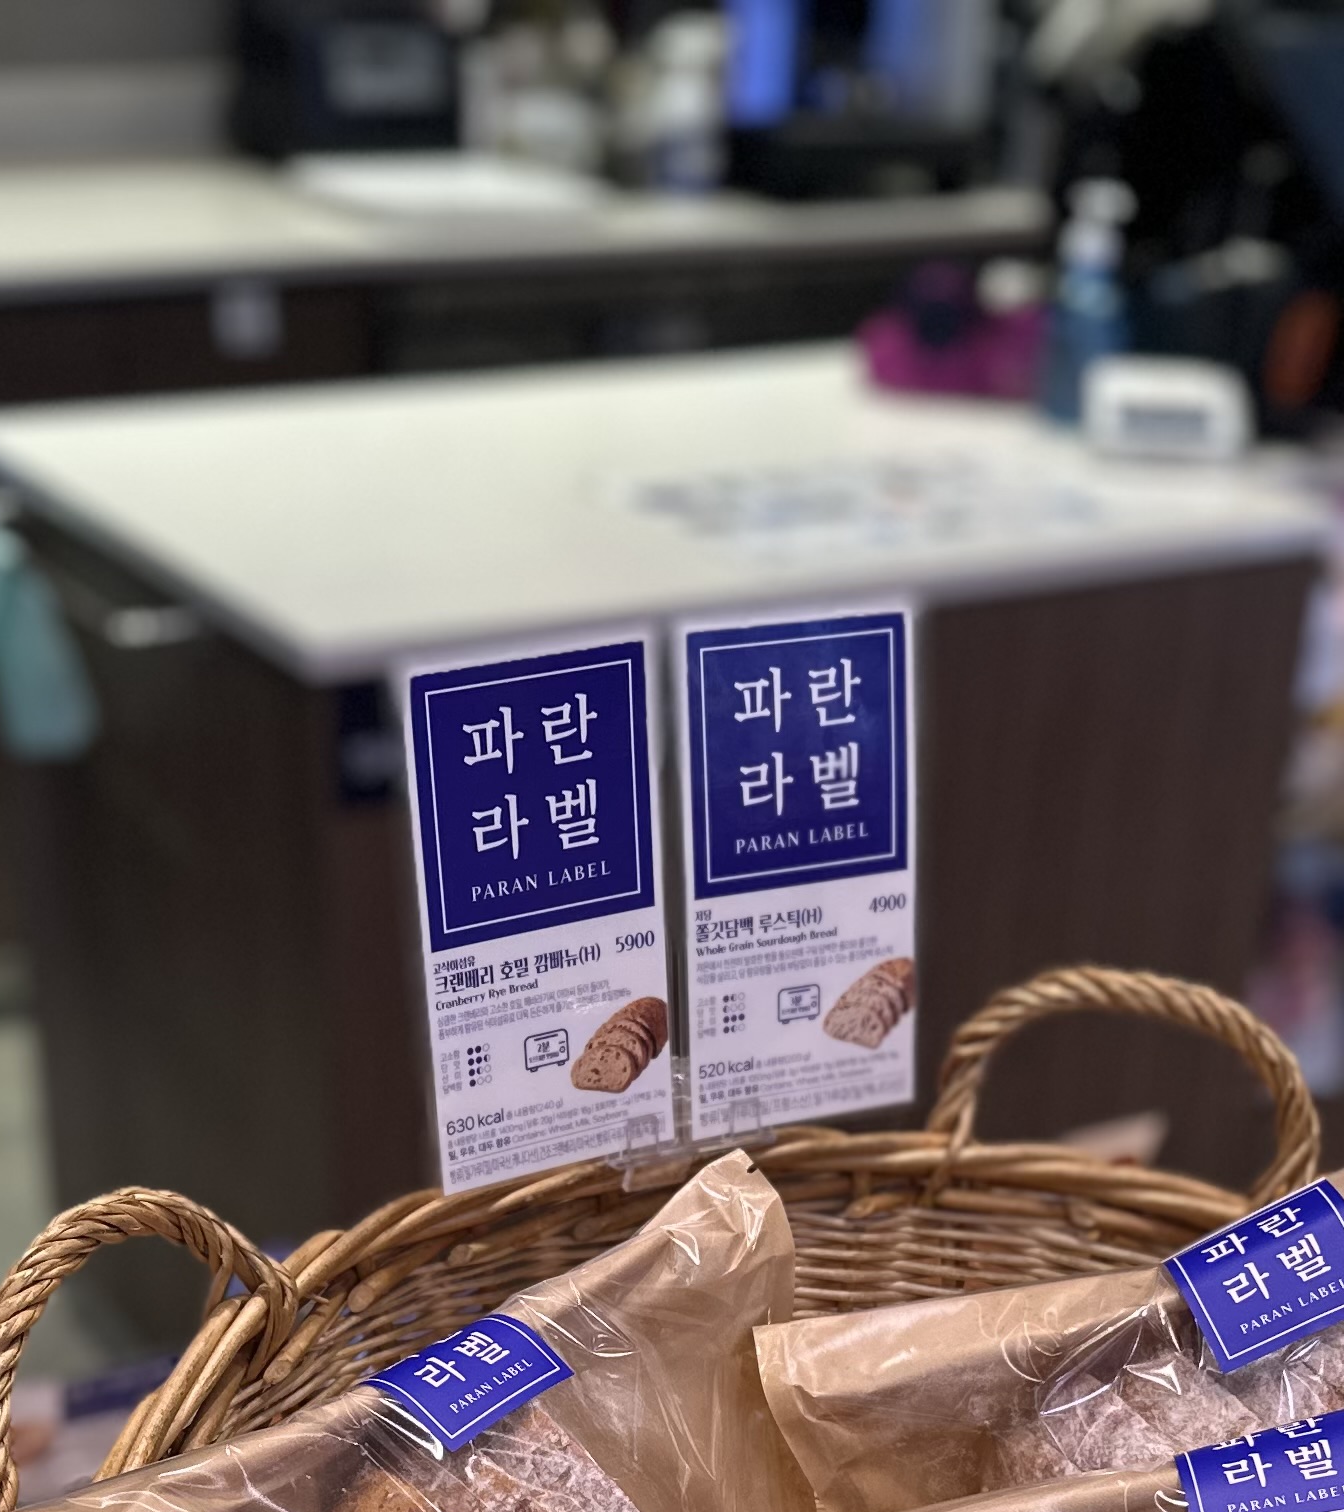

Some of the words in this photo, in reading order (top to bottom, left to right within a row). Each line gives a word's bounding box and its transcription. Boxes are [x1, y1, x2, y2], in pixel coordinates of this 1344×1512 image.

[733, 658, 861, 733] 파란
[462, 693, 597, 774] 파란
[739, 741, 859, 816] 라벨
[471, 779, 599, 859] 라벨
[735, 830, 800, 855] PARAN
[809, 821, 869, 845] LABEL
[470, 872, 538, 903] PARAN
[548, 860, 611, 886] LABEL
[868, 892, 906, 914] 4900
[615, 929, 655, 954] 5900
[695, 915, 753, 944] 쫄깃담백
[758, 905, 822, 934] 루스틱(H)
[696, 943, 726, 957] Whole
[728, 939, 753, 952] Grain
[756, 930, 806, 949] Sourdough
[809, 926, 837, 940] Bread
[433, 954, 476, 973] 고식이섬유
[434, 963, 494, 996] 크랜베리
[499, 956, 529, 982] 호밀
[534, 942, 601, 974] 깜빠뉴(H)
[435, 990, 485, 1012] Cranberry
[488, 986, 505, 1000] Rye
[508, 978, 539, 994] Bread
[699, 1061, 725, 1079] 520
[728, 1056, 754, 1074] kcal
[446, 1115, 474, 1136] 630
[477, 1108, 504, 1128] kcal
[1201, 1207, 1304, 1263] 파란
[1223, 1233, 1331, 1304] 라벨
[1240, 1302, 1293, 1334] PARAN
[414, 1332, 510, 1387] 라벨
[449, 1382, 493, 1413] PARAN
[493, 1358, 533, 1385] LABEL
[1222, 1440, 1337, 1487] 라벨
